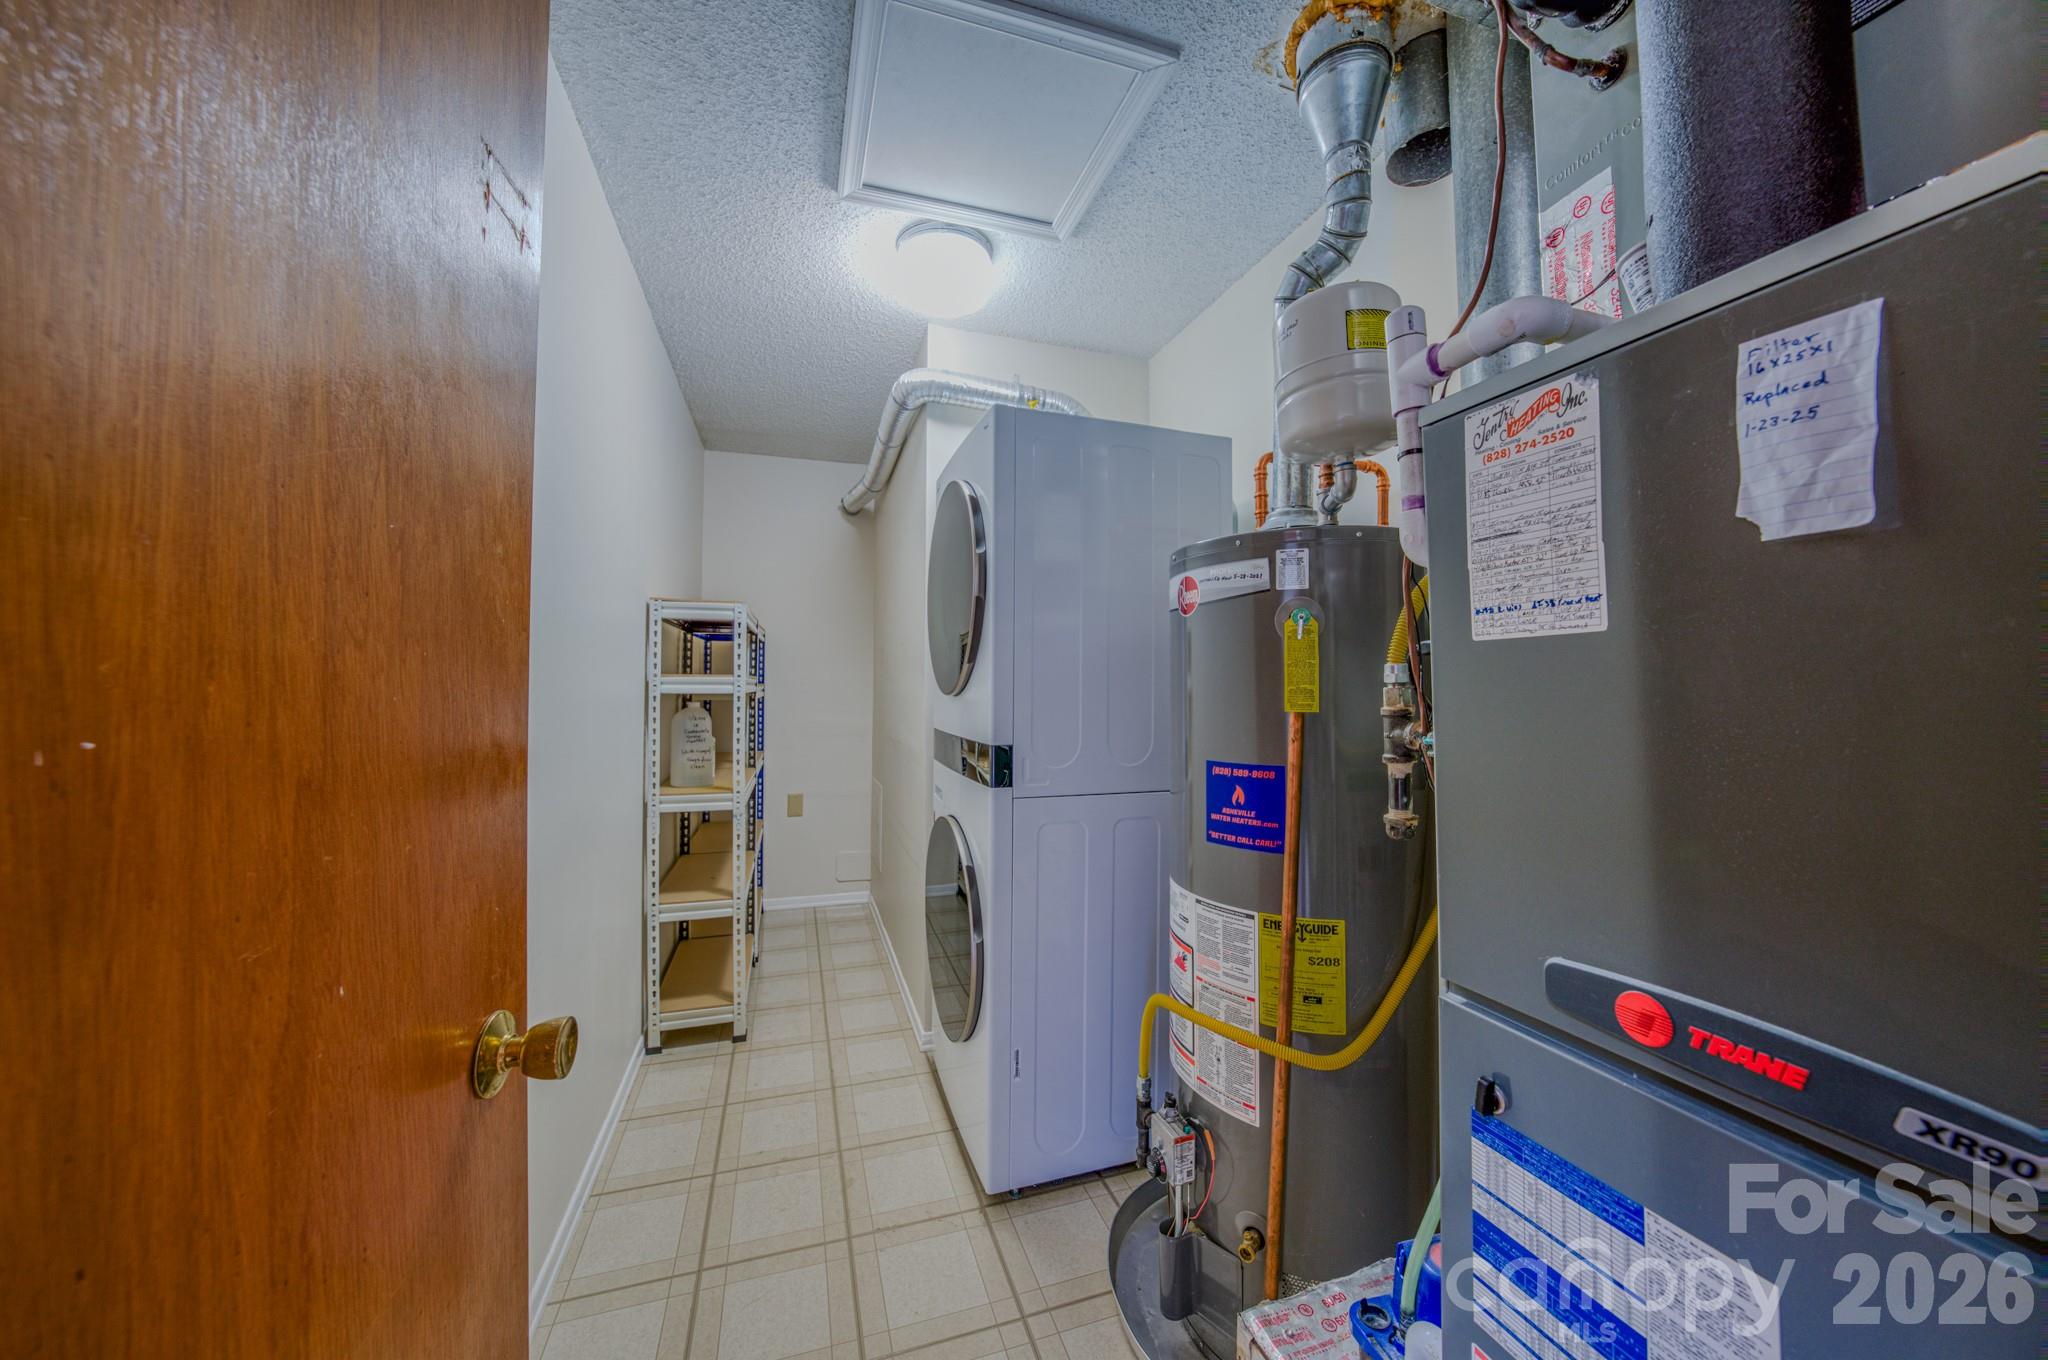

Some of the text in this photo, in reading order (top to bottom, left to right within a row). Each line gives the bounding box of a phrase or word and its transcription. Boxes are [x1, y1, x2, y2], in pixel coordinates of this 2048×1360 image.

[1748, 332, 1819, 361] Filter
[1744, 370, 1829, 407] Replaced
[1508, 388, 1560, 437] HEATING
[1745, 405, 1820, 438] 1-23-25
[1482, 427, 1575, 466] (828) 274-2520
[1212, 766, 1232, 777] (828)
[1211, 813, 1231, 822] WATER
[1222, 807, 1256, 818] ASHEVILLE
[1237, 837, 1254, 845] CALL
[1688, 1025, 1809, 1091] TRANE
[1914, 1117, 2039, 1180] XR90
